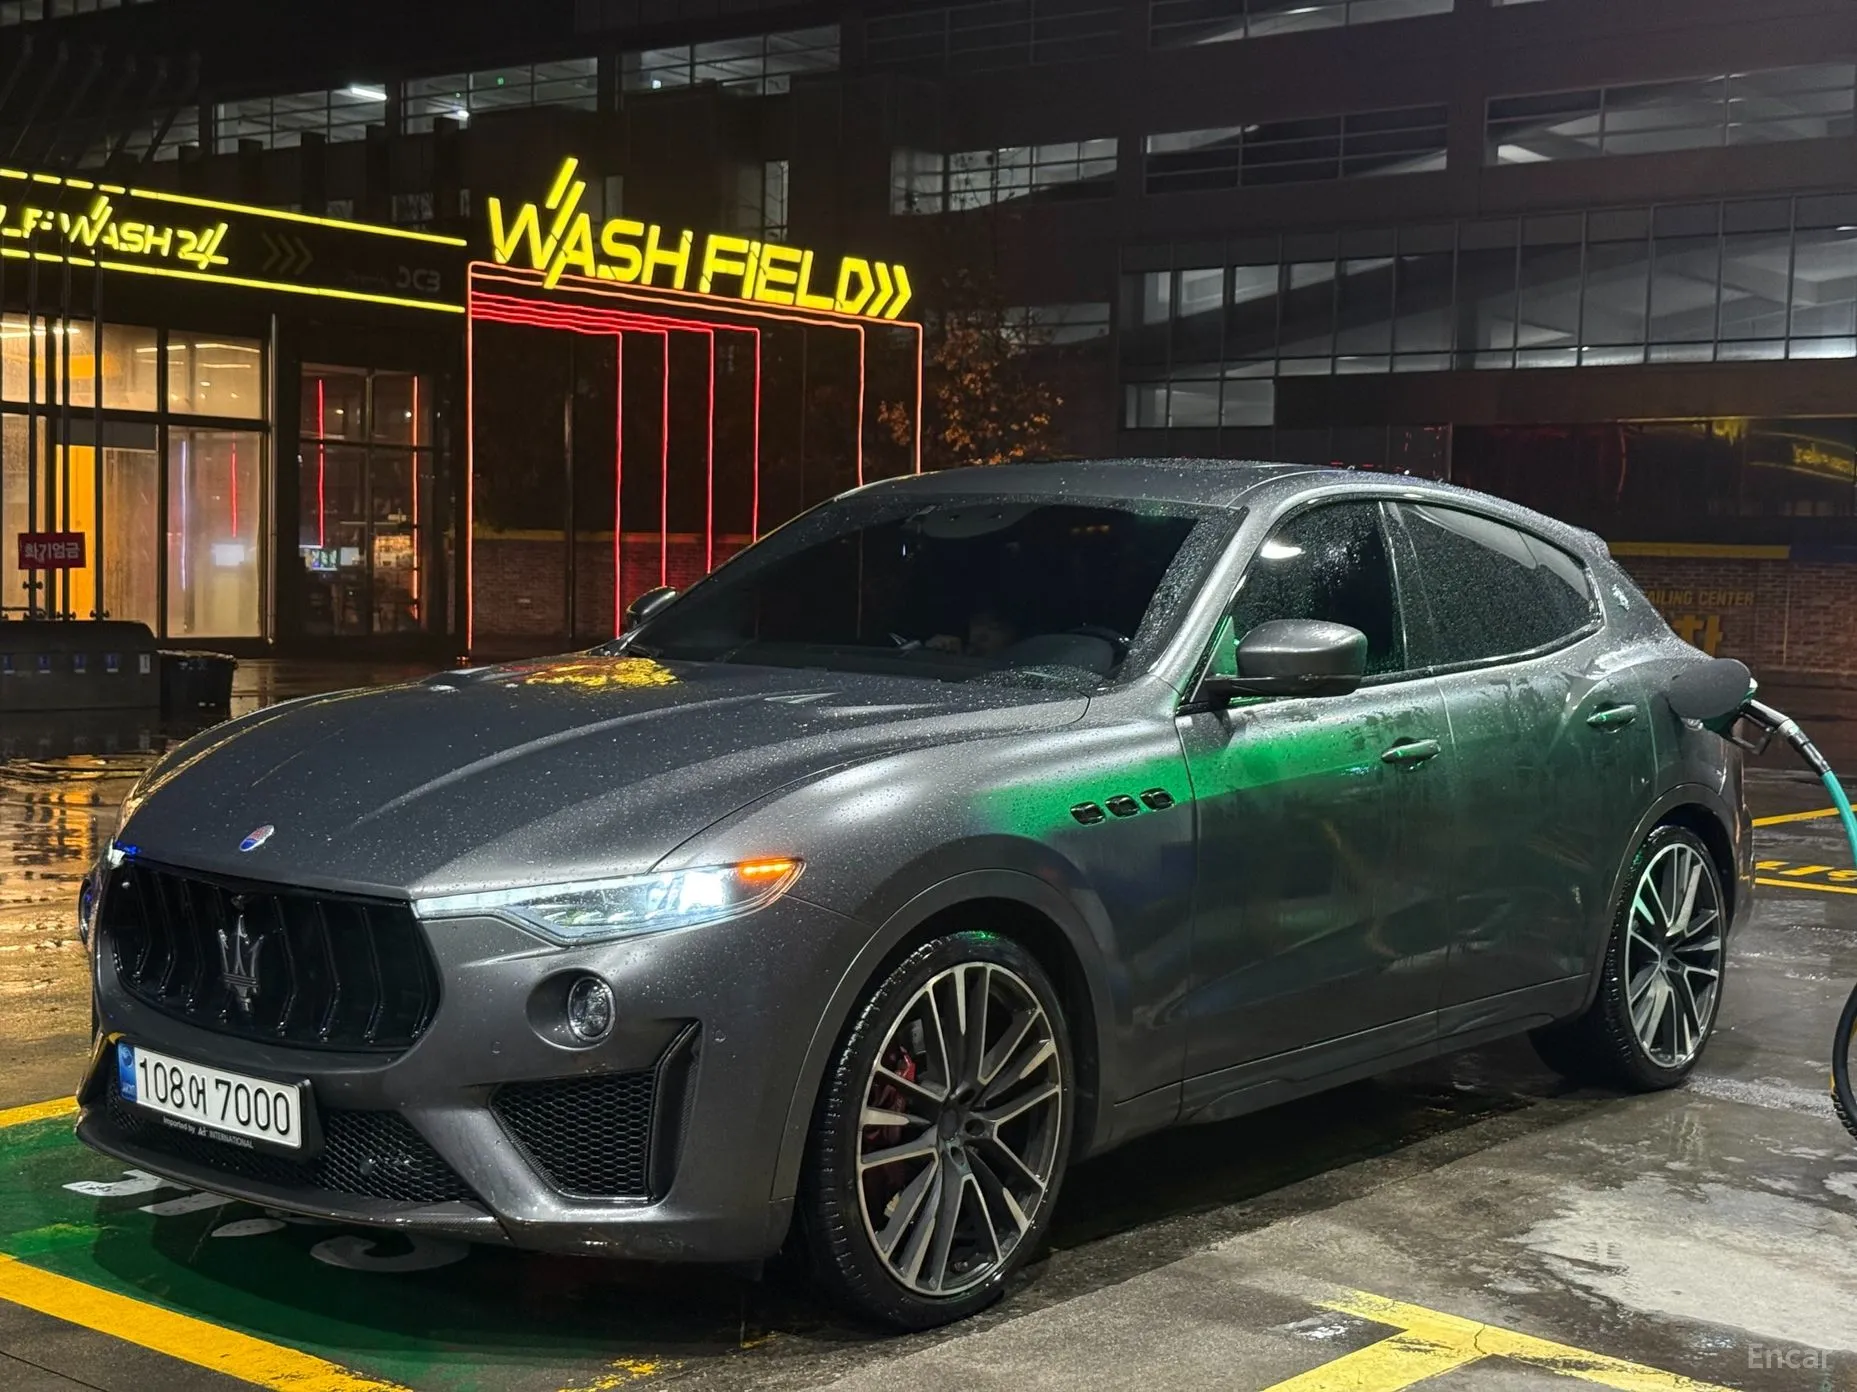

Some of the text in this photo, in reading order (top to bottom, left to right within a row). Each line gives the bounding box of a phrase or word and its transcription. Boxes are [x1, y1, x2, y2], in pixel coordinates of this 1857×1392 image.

[60, 196, 173, 257] WASH
[178, 222, 229, 270] 24
[488, 157, 693, 290] WASH
[24, 541, 80, 563] 화기엄금
[1700, 591, 1755, 606] CENTER
[139, 1056, 290, 1136] 108어 7000
[209, 1130, 254, 1149] INTERNATIONAL
